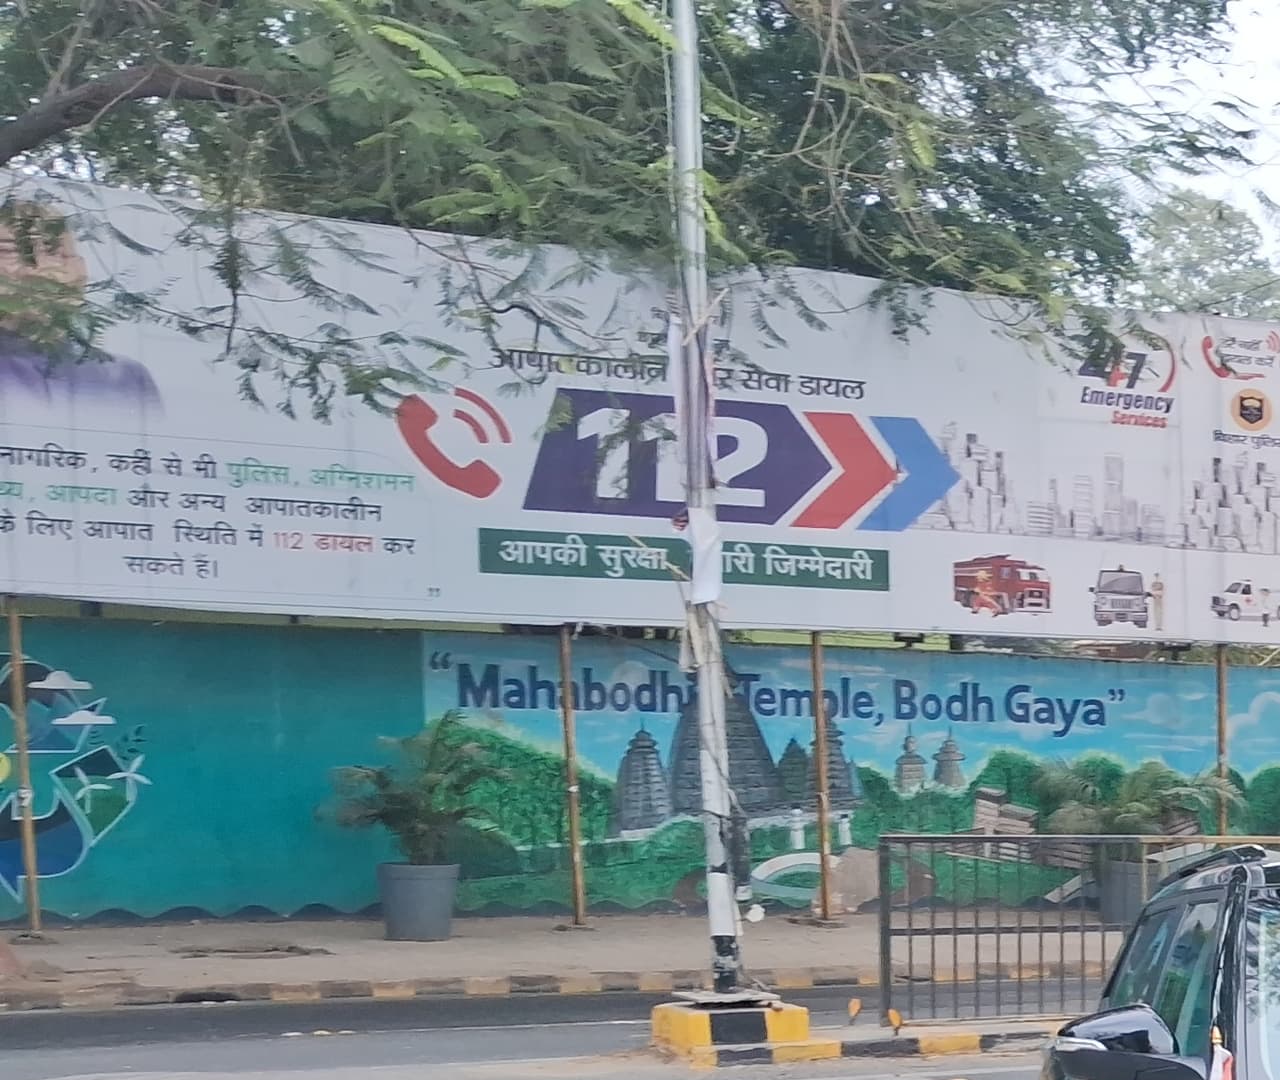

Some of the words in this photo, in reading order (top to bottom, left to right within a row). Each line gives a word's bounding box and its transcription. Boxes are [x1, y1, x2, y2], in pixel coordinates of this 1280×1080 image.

[798, 374, 866, 400] डायल
[1081, 386, 1175, 413] Emergency
[1111, 410, 1168, 428] Services
[160, 451, 183, 477] से
[192, 453, 217, 479] भी
[311, 463, 416, 492] अग्निशमन
[577, 407, 768, 508] 112
[46, 484, 118, 506] आपदा
[127, 482, 170, 509] और
[178, 492, 226, 513] अन्य
[245, 496, 382, 522] आपातकालीन
[25, 510, 73, 541] लिए
[83, 520, 153, 542] आपात
[173, 518, 237, 547] स्थिति
[245, 523, 264, 548] में
[272, 531, 304, 550] 112
[311, 533, 373, 553] डायल
[381, 537, 416, 555] कर
[122, 551, 185, 577] सकते
[499, 532, 588, 568] आपकी
[597, 544, 669, 579] सुरक्षा
[765, 545, 874, 581] जिम्मेदारी
[892, 678, 995, 723] Bodh
